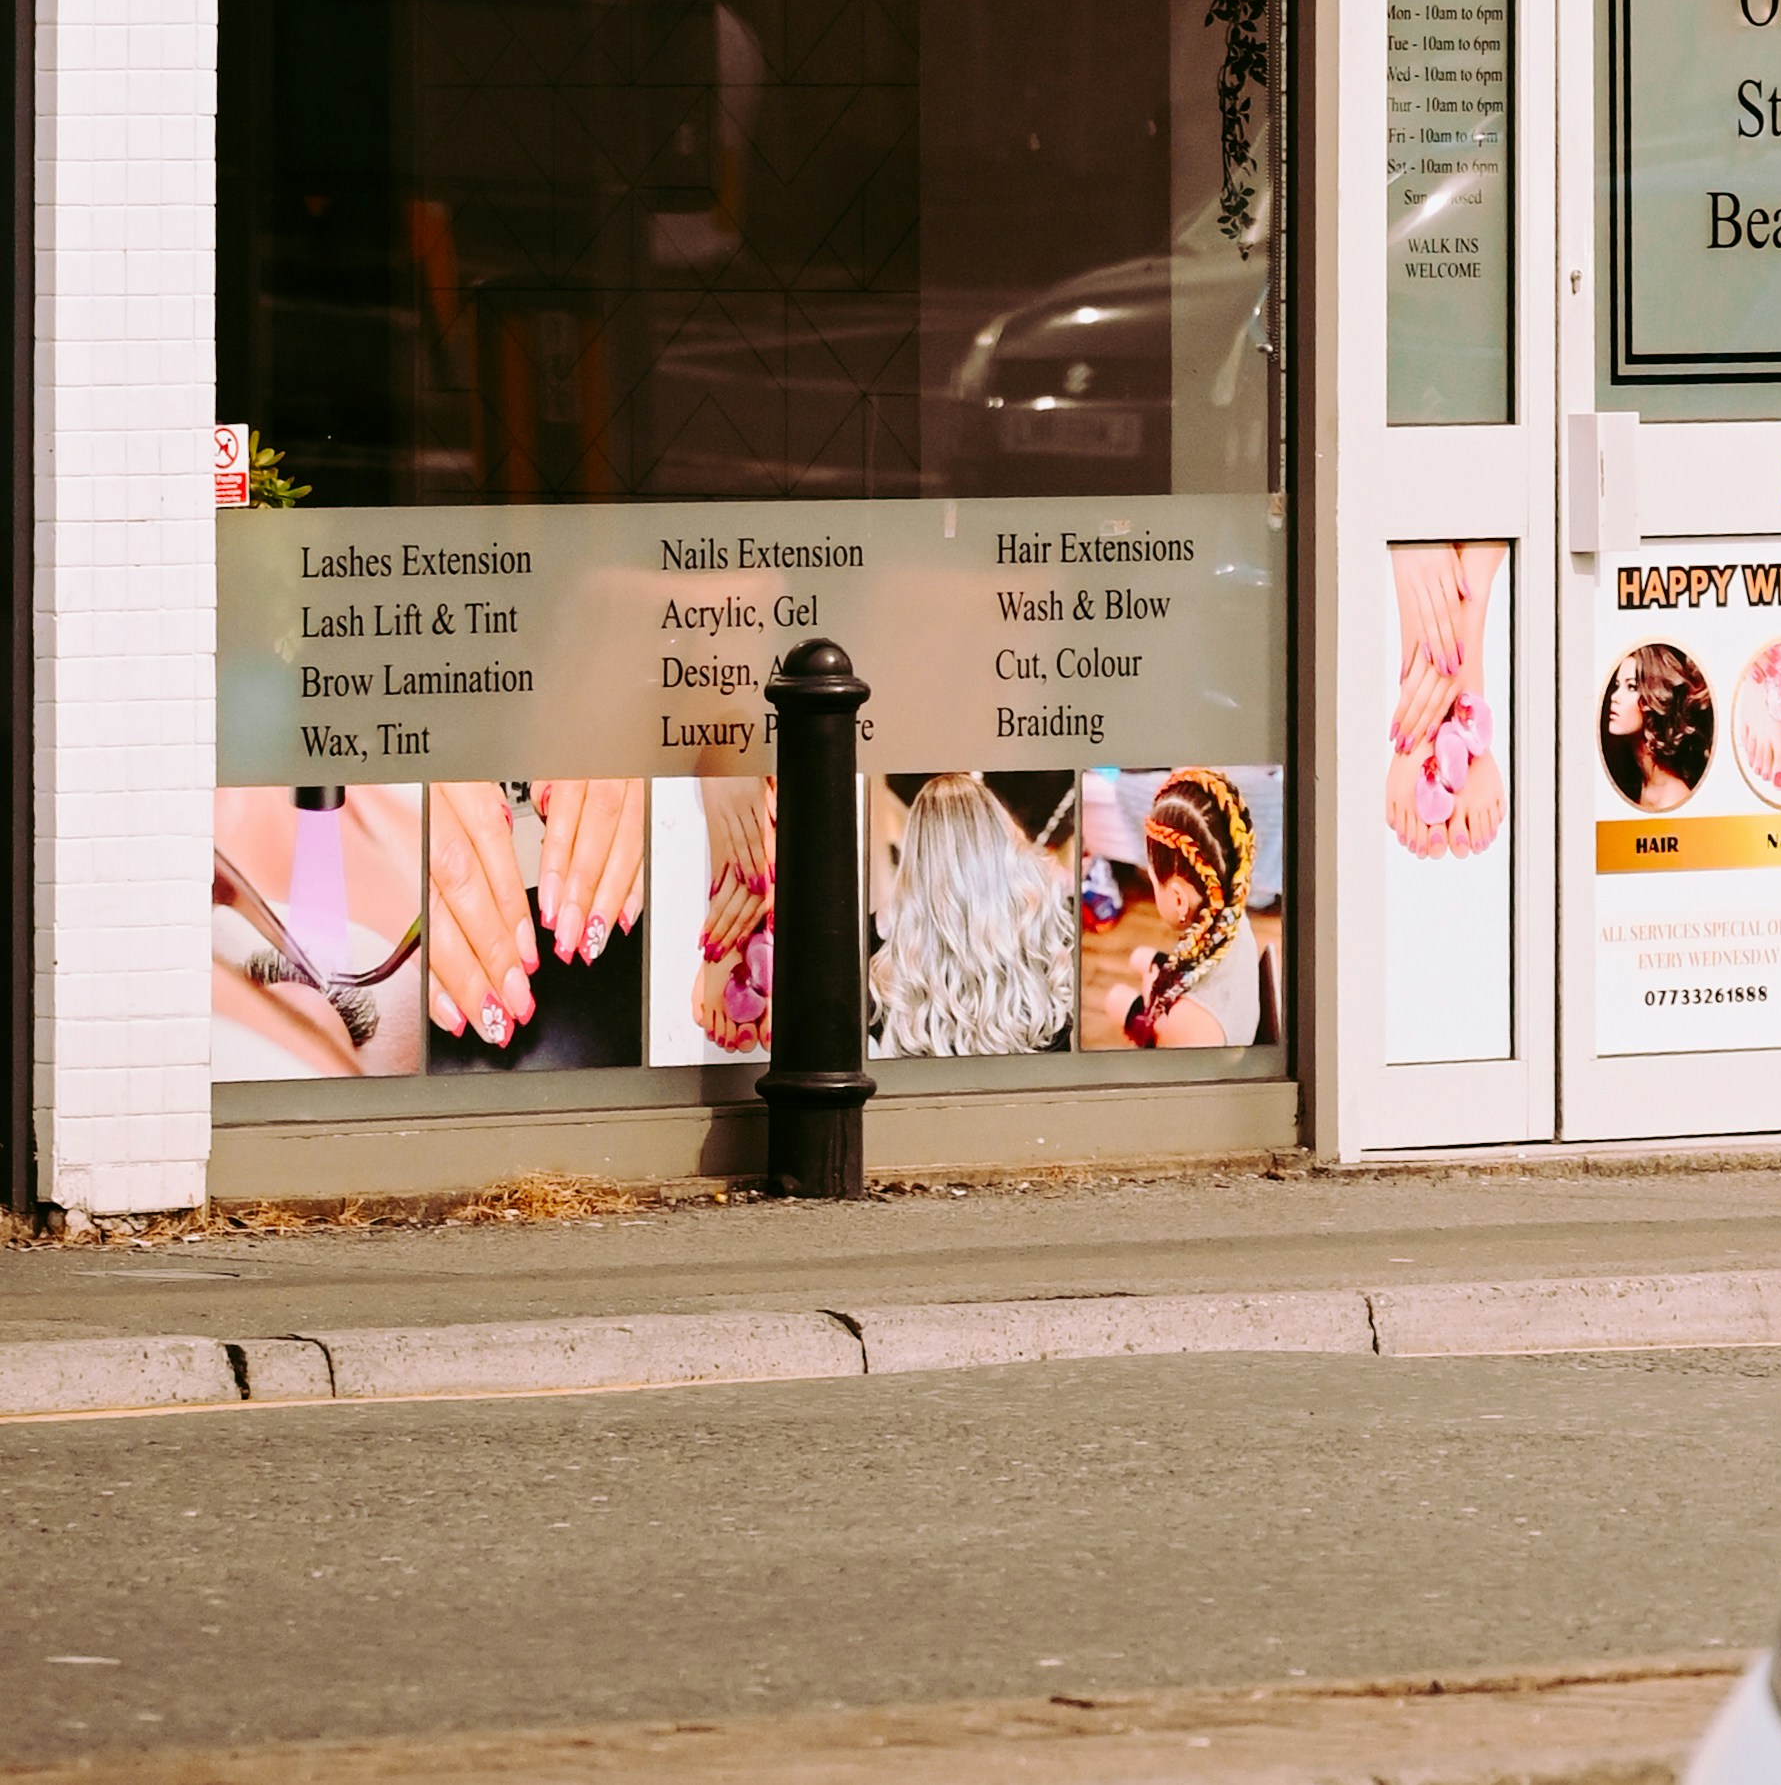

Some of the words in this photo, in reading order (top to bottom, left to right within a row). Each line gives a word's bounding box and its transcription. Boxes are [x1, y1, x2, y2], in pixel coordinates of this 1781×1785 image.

[1425, 5, 1458, 21] 10am
[1461, 6, 1473, 21] to
[1476, 5, 1504, 25] 6pm
[1423, 36, 1455, 51] 10am
[1458, 37, 1470, 51] to
[1473, 36, 1501, 55] 6pm
[1424, 66, 1457, 82] 10am
[1461, 69, 1473, 82] to
[1476, 67, 1503, 86] 6pm
[1426, 97, 1458, 112] 10am
[1461, 99, 1473, 112] to
[1477, 97, 1504, 116] 6pm
[1388, 128, 1406, 143] Fri
[1420, 128, 1452, 143] 10am
[1456, 129, 1467, 143] to
[1387, 159, 1407, 174] Sat
[1420, 159, 1453, 174] 10am
[1456, 161, 1468, 174] to
[1472, 159, 1499, 177] 6pm
[1447, 190, 1482, 205] losed
[1408, 238, 1451, 254] WALK
[1455, 238, 1480, 254] INS
[1405, 262, 1482, 278] WELCOME
[300, 546, 392, 579] Lashes
[401, 542, 533, 577] Extension
[661, 537, 730, 571] Nails
[737, 535, 865, 570] Extension
[996, 532, 1052, 565] Hair
[1060, 530, 1195, 564] Extensions
[1617, 564, 1738, 610] HAPPY
[300, 605, 364, 639] Lash
[374, 603, 422, 637] Lift
[430, 604, 456, 637] &
[464, 601, 519, 635] Tint
[661, 595, 766, 636] Acrylic,
[773, 593, 818, 628] Gel
[996, 590, 1063, 623] Wash
[1072, 590, 1096, 621] &
[1104, 588, 1172, 621] Blow
[300, 666, 374, 699] Brow
[383, 660, 534, 696] Lamination
[661, 656, 760, 694] Design,
[995, 650, 1047, 685] Cut,
[1055, 646, 1143, 679] Colour
[661, 715, 755, 753] Luxury
[996, 706, 1105, 744] Braiding
[300, 726, 369, 762] Wax,
[377, 723, 431, 756] Tint
[1634, 835, 1680, 855] HAIR
[1600, 926, 1627, 943] ALL
[1630, 922, 1701, 942] SERVICES
[1703, 920, 1765, 939] SPECIAL
[1637, 951, 1685, 970] EVERY
[1687, 947, 1781, 968] WEDNESDAY
[1644, 985, 1768, 1006] 07733261888
